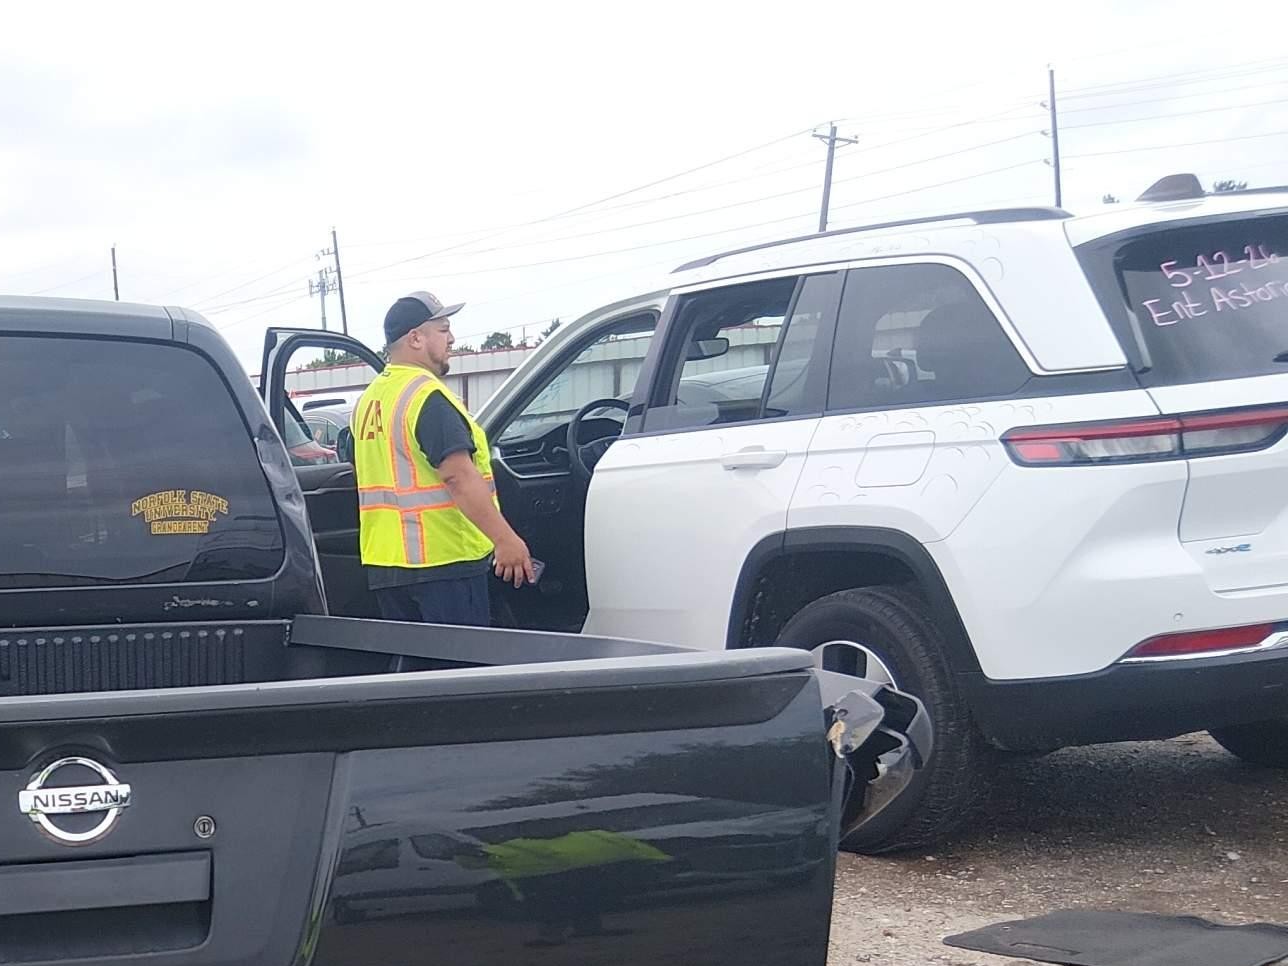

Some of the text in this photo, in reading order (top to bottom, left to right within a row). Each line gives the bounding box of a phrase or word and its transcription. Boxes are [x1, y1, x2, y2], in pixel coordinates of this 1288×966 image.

[132, 489, 229, 516] NORFOLK STATE
[144, 503, 217, 523] UNIVERSITY
[151, 521, 209, 534] GRANDPARENT
[33, 789, 119, 809] NISSAN
